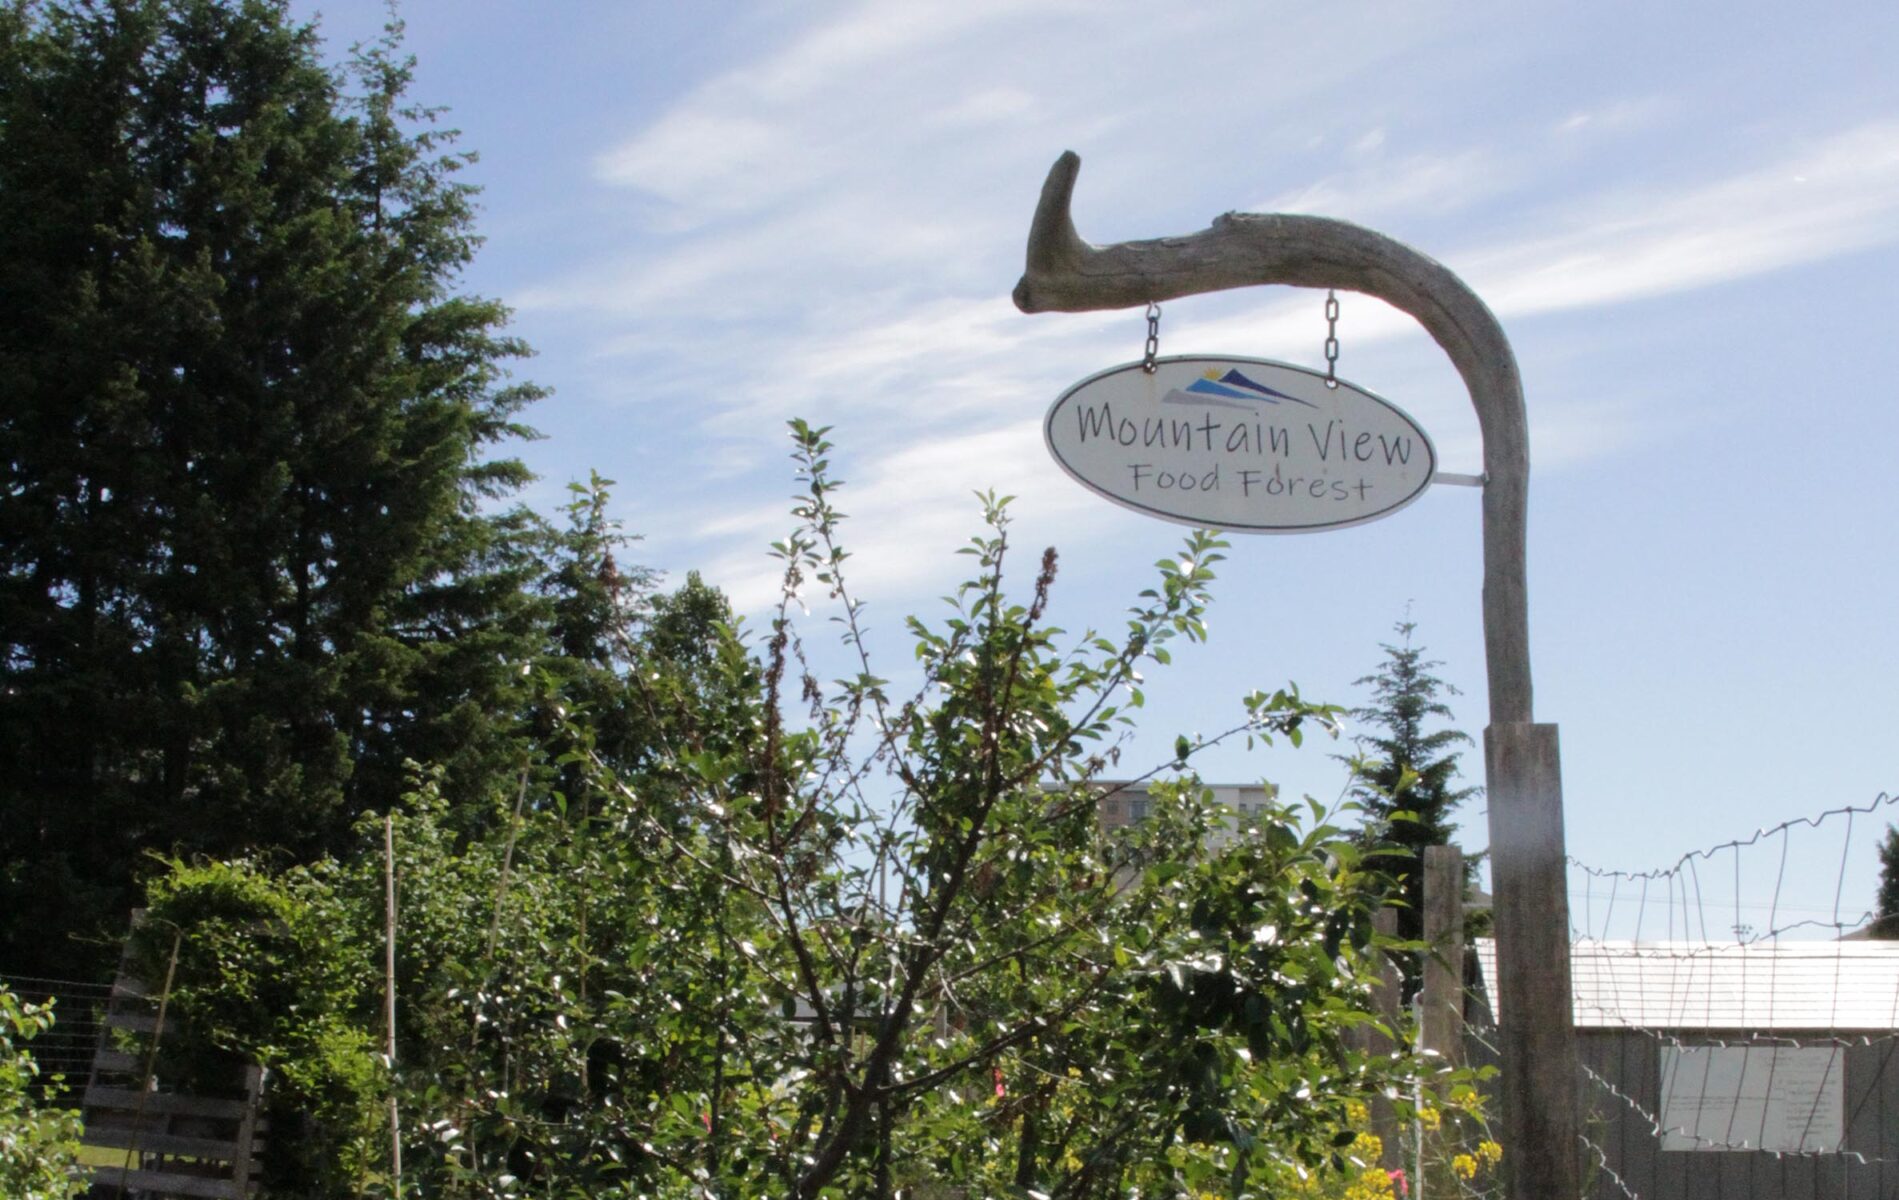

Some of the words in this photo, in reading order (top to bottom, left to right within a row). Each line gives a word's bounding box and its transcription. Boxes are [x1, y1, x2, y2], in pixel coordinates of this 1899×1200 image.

[1077, 402, 1289, 458] Mountain
[1308, 419, 1411, 466] View
[1127, 463, 1220, 492] Food
[1237, 470, 1374, 501] Forest
